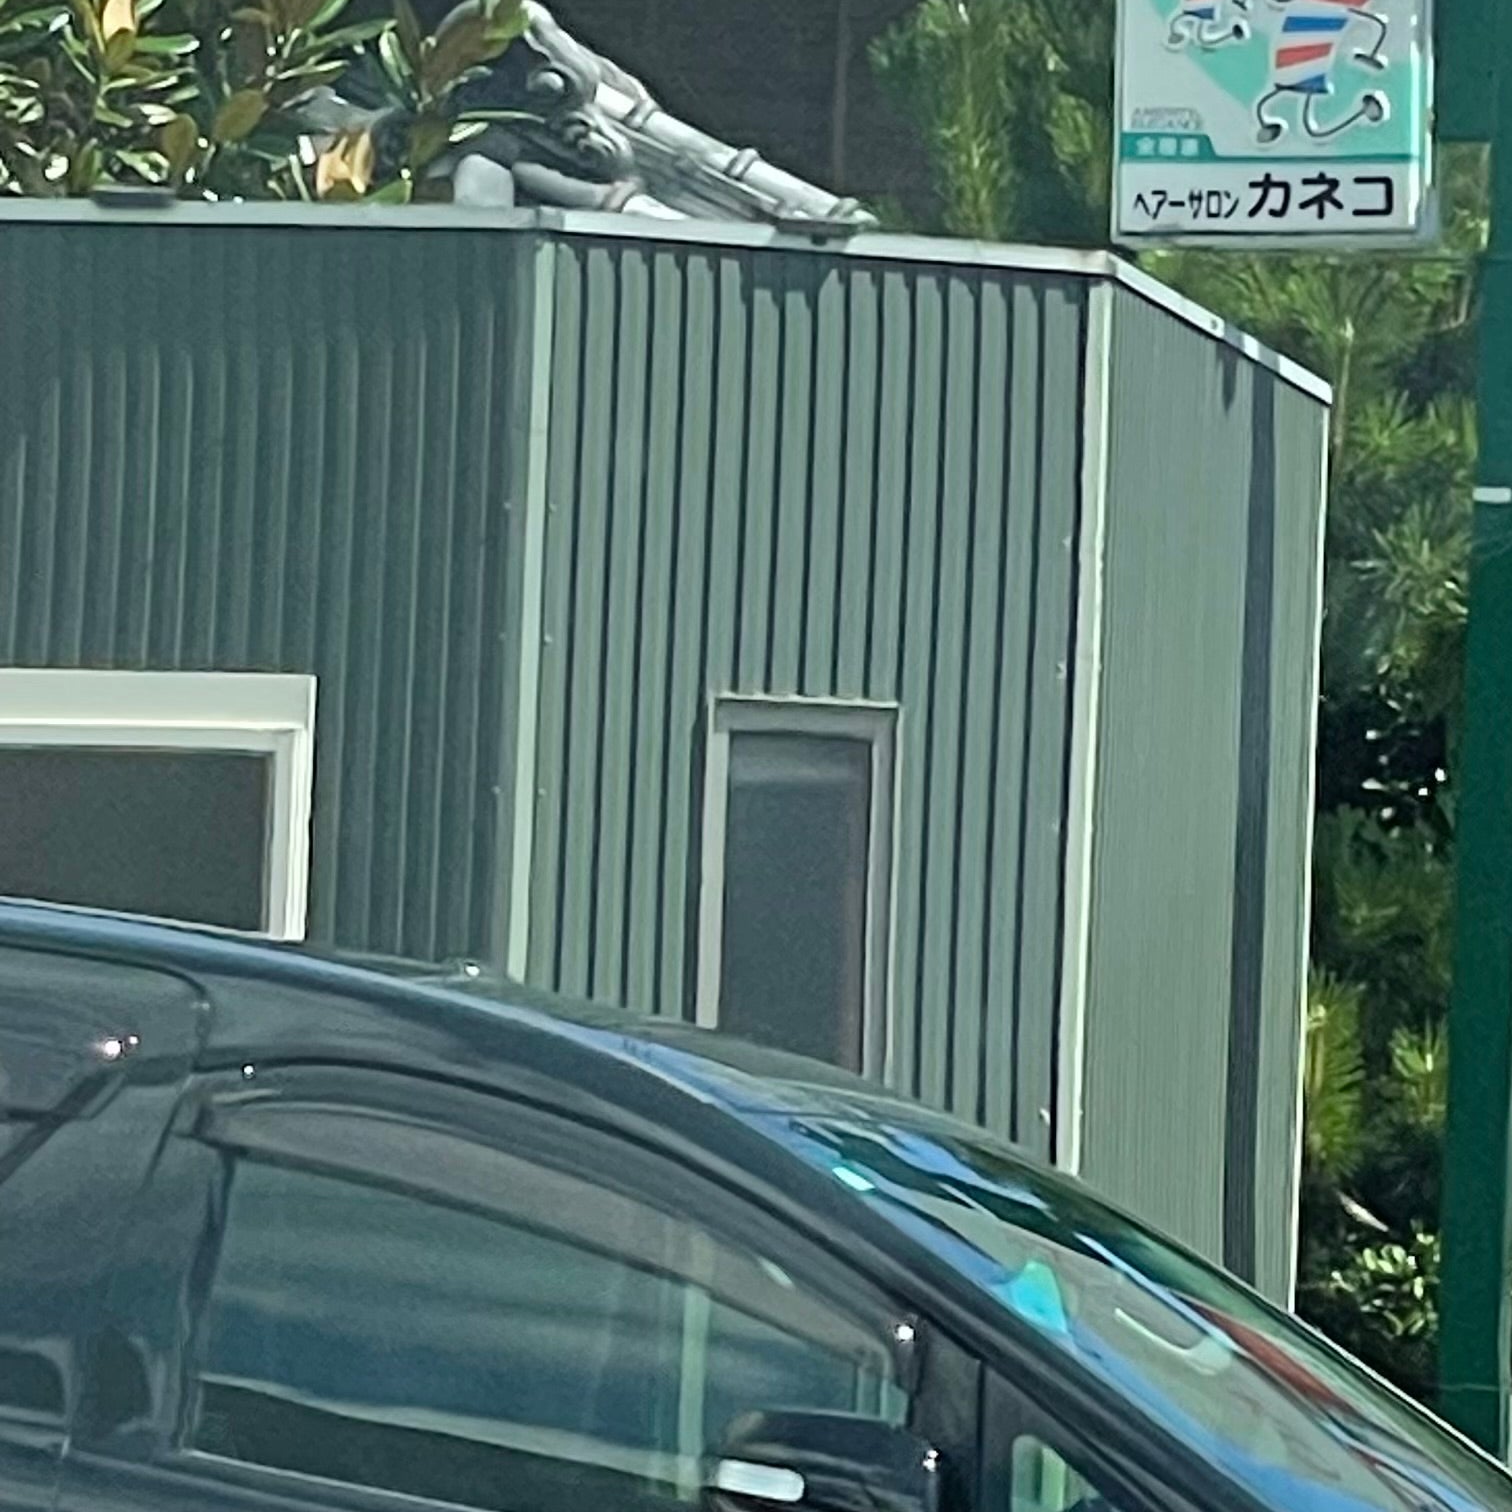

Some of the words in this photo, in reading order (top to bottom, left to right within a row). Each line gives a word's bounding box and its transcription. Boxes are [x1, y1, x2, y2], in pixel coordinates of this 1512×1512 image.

[1133, 188, 1240, 221] ヘアーサロン
[1247, 172, 1395, 220] カネコ
